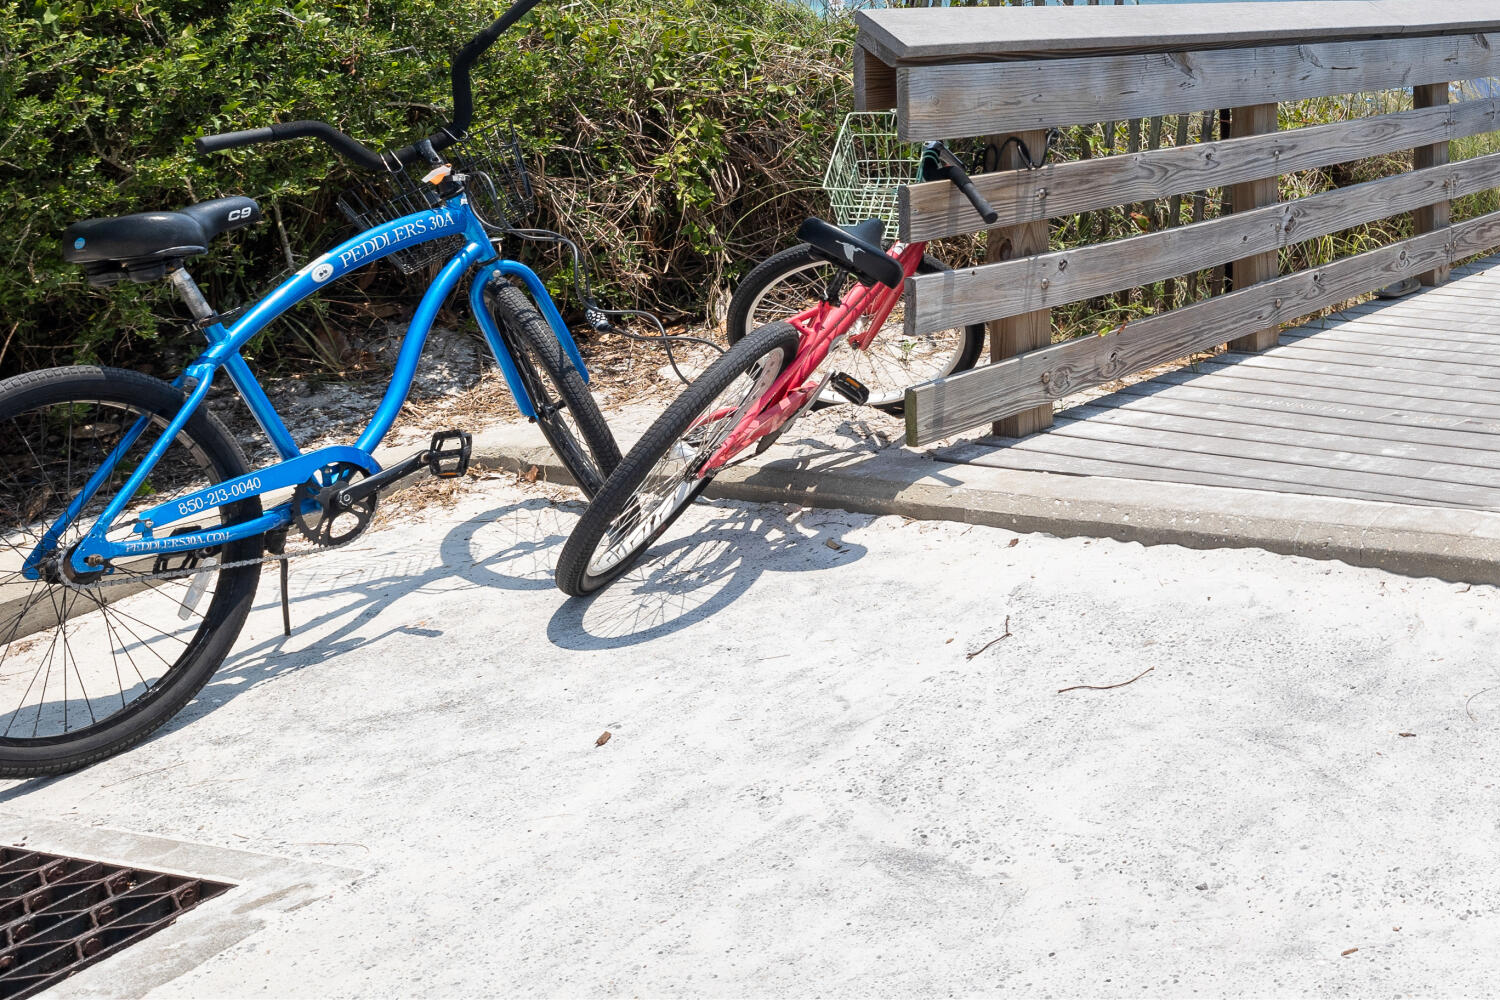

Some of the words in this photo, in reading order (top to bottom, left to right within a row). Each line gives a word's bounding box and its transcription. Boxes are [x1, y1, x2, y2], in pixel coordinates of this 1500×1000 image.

[228, 206, 252, 222] C9
[338, 219, 427, 269] PEDDLERS
[428, 212, 455, 231] 30A
[177, 476, 262, 515] 850-213-0040
